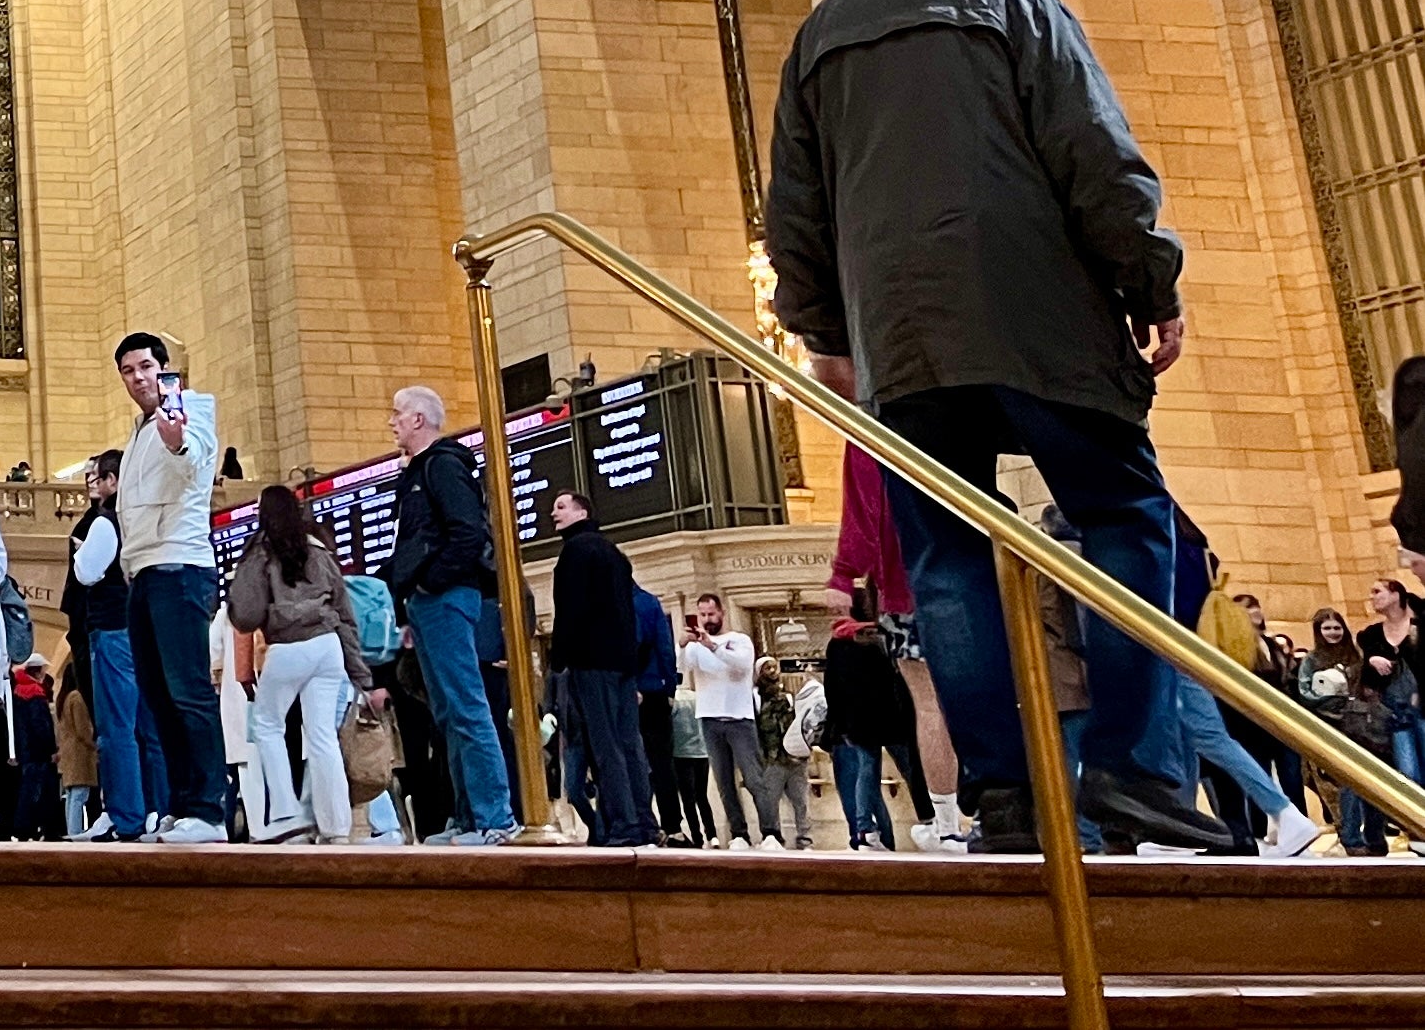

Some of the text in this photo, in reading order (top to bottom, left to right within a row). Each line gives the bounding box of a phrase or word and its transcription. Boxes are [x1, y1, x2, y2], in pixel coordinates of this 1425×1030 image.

[732, 553, 829, 568] CUSTOMER SERV
[24, 586, 54, 601] KET
